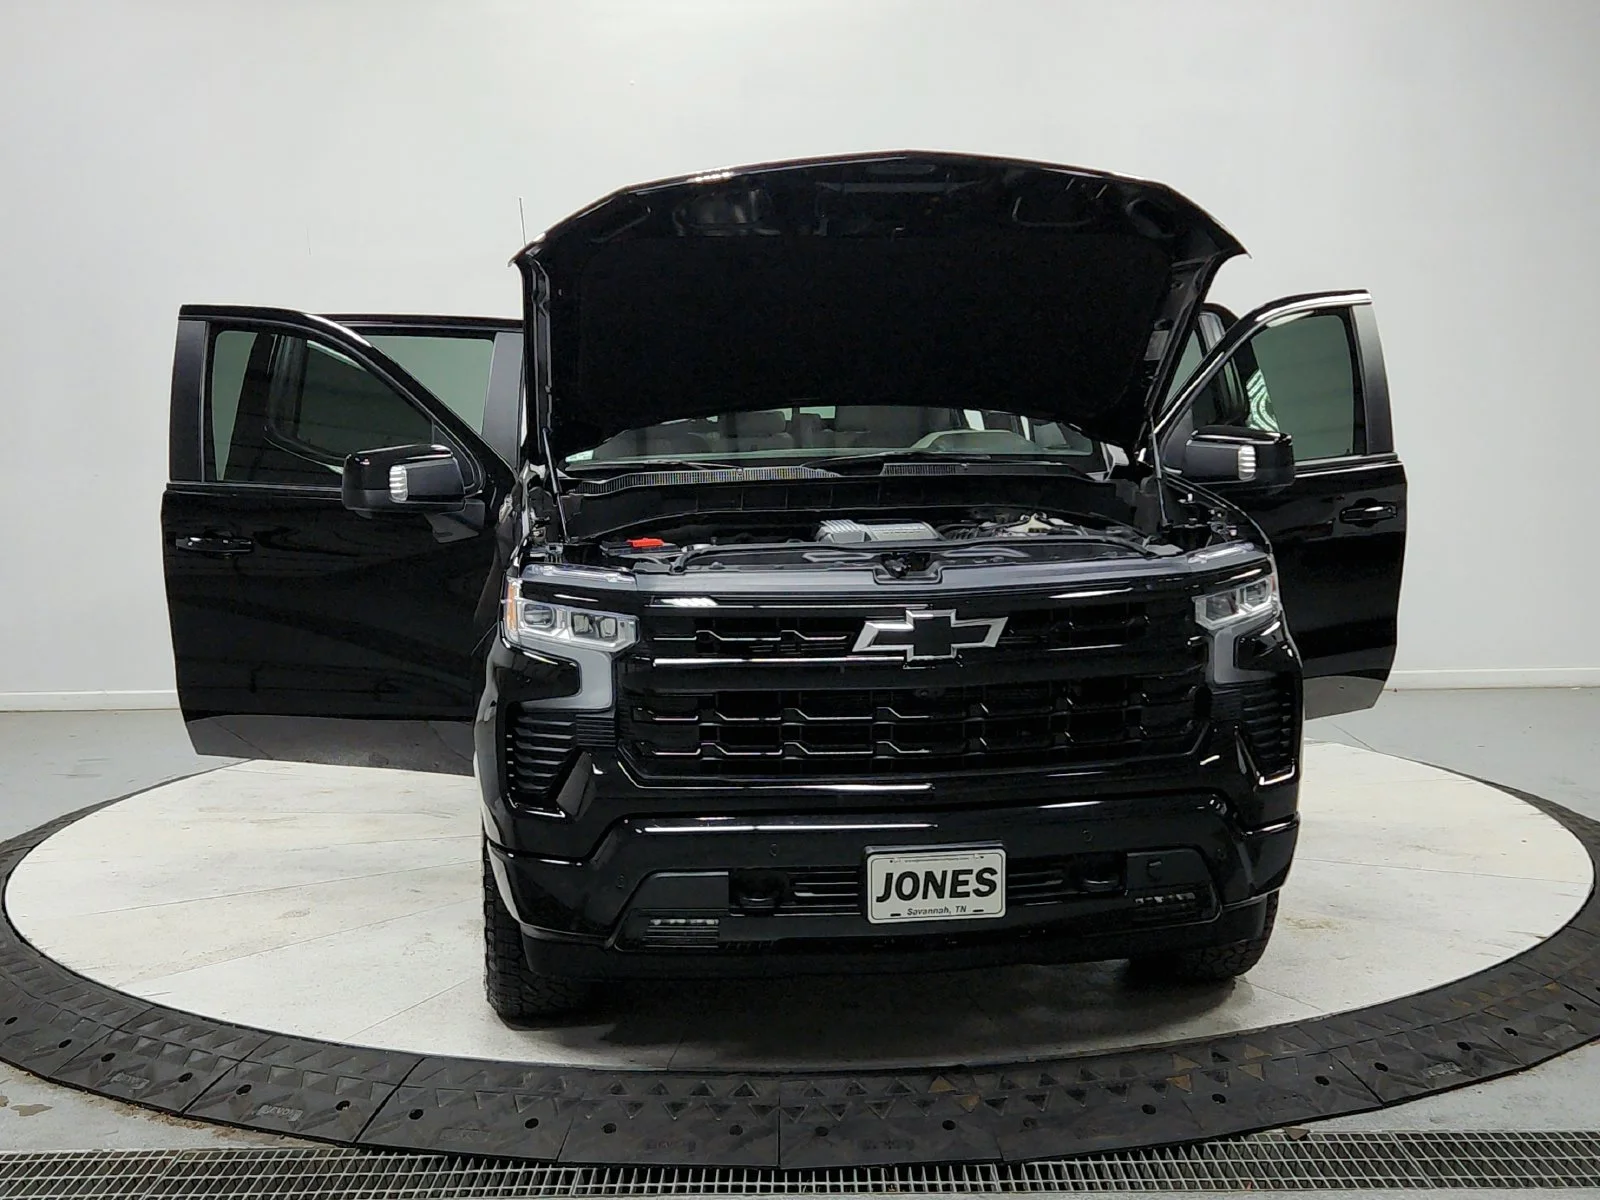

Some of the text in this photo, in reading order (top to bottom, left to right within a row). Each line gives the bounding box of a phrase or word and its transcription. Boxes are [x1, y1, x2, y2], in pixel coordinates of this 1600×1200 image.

[876, 867, 998, 903] JONES
[907, 905, 967, 916] Savannah, TN
